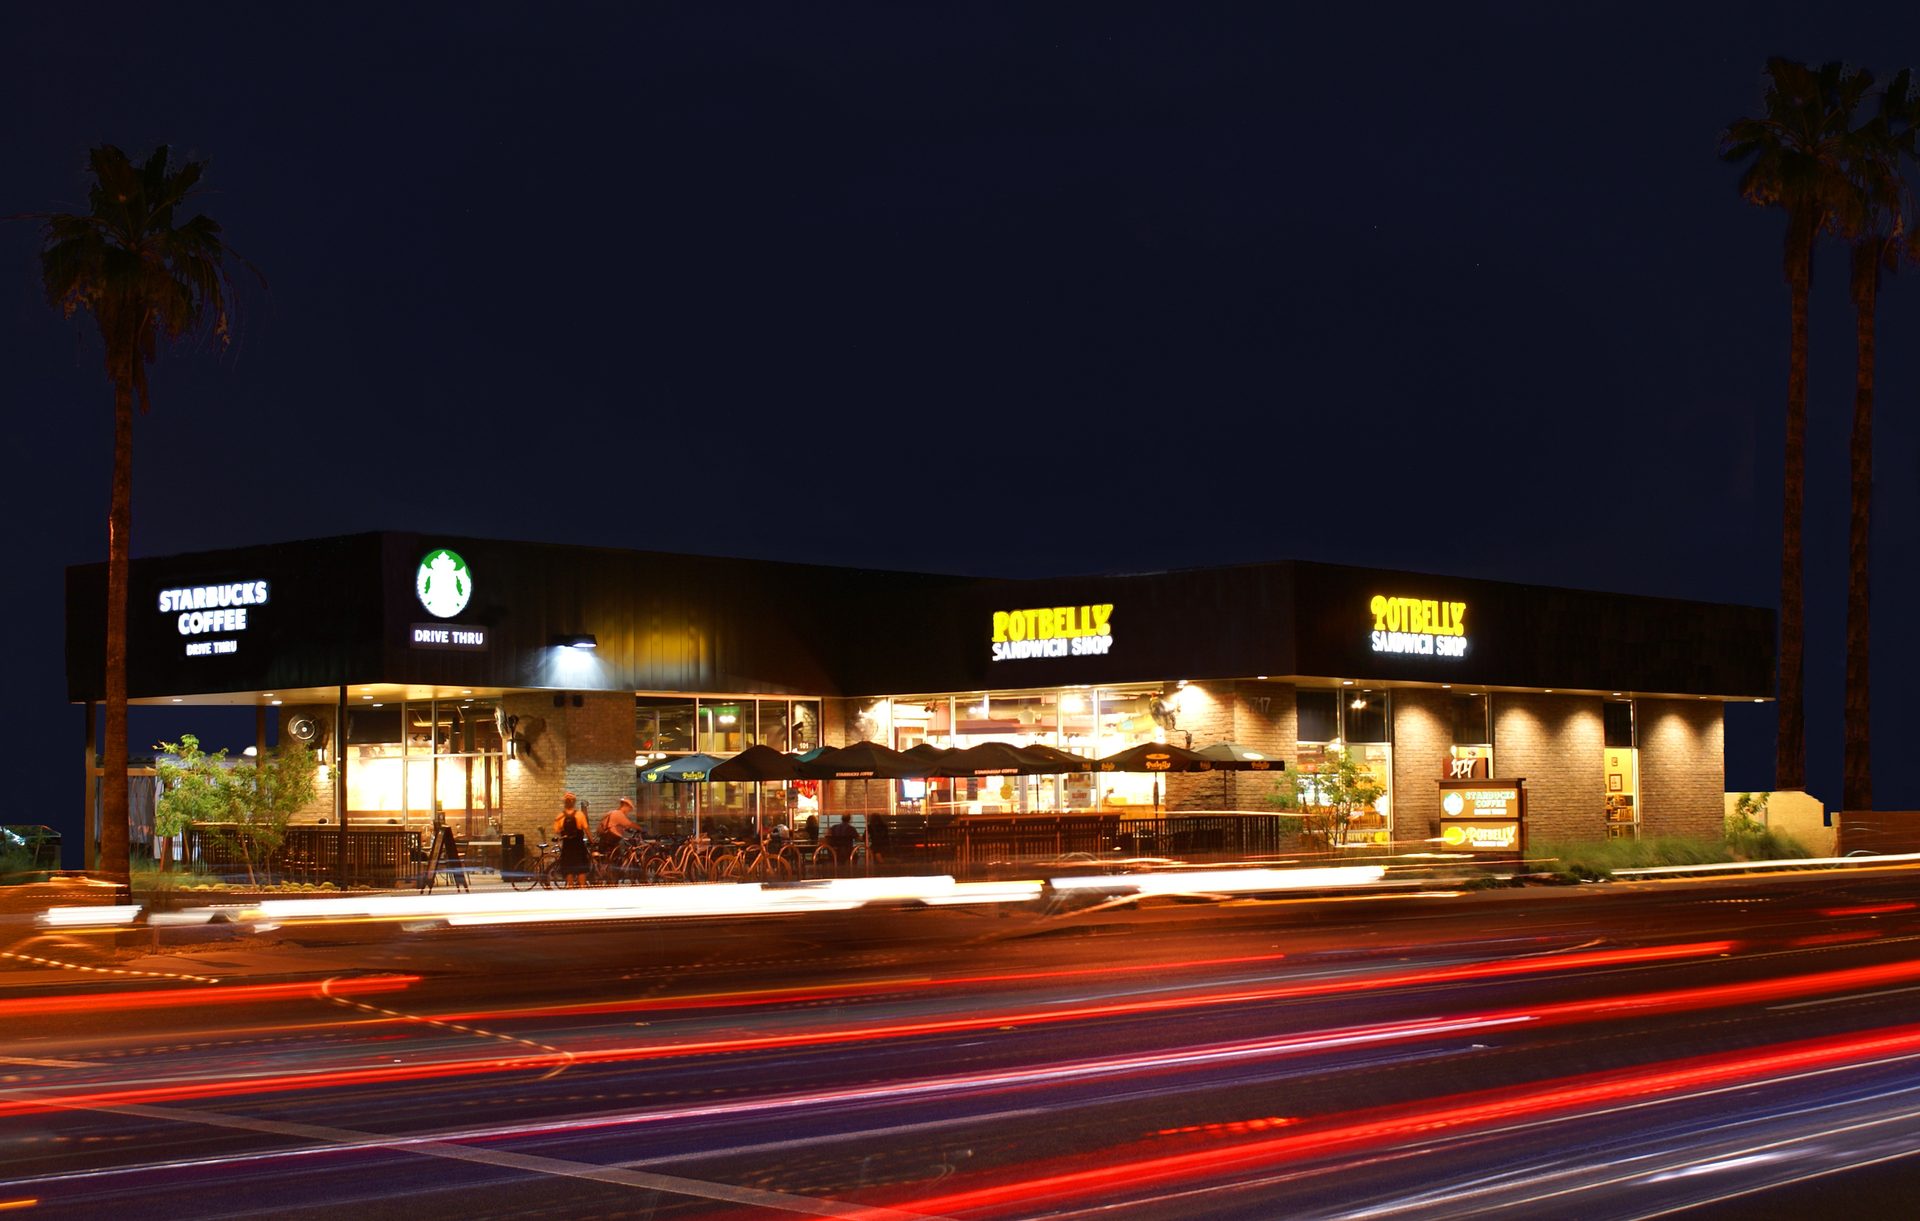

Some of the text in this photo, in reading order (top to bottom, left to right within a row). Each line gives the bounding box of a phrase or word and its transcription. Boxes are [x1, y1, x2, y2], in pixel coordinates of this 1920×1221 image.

[159, 581, 268, 612] STARBUCKS
[177, 608, 247, 635] COFFEE
[991, 604, 1114, 642] POTBELLY
[1370, 595, 1467, 637] POTBELLY
[186, 640, 238, 656] DRIVE THRU
[414, 629, 484, 645] DRIVE THRU
[991, 635, 1114, 661] SANDWICH SHOP
[1371, 631, 1468, 657] SANDWICH SHOP
[1465, 791, 1515, 800] STARBUCKS
[1475, 800, 1507, 808] COFFEE
